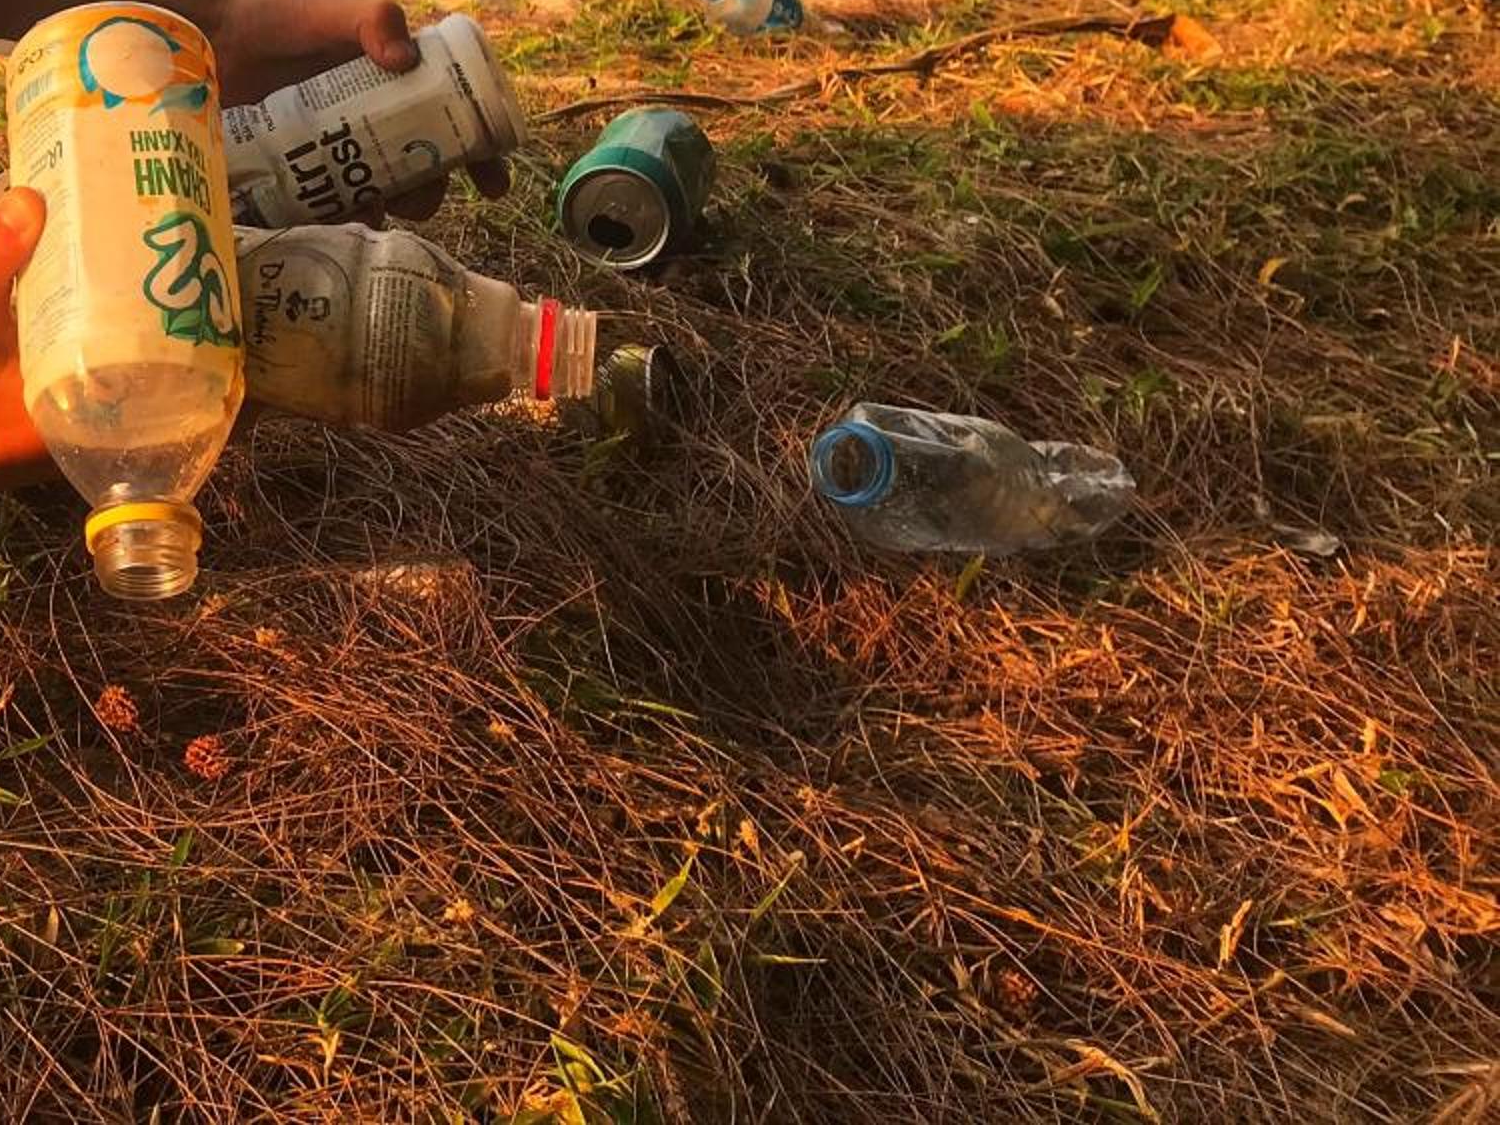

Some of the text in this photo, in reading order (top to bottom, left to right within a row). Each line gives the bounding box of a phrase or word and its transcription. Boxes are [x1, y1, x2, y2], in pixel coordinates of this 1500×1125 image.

[129, 129, 185, 153] XANH
[133, 158, 212, 216] CHANH
[143, 215, 238, 338] C2
